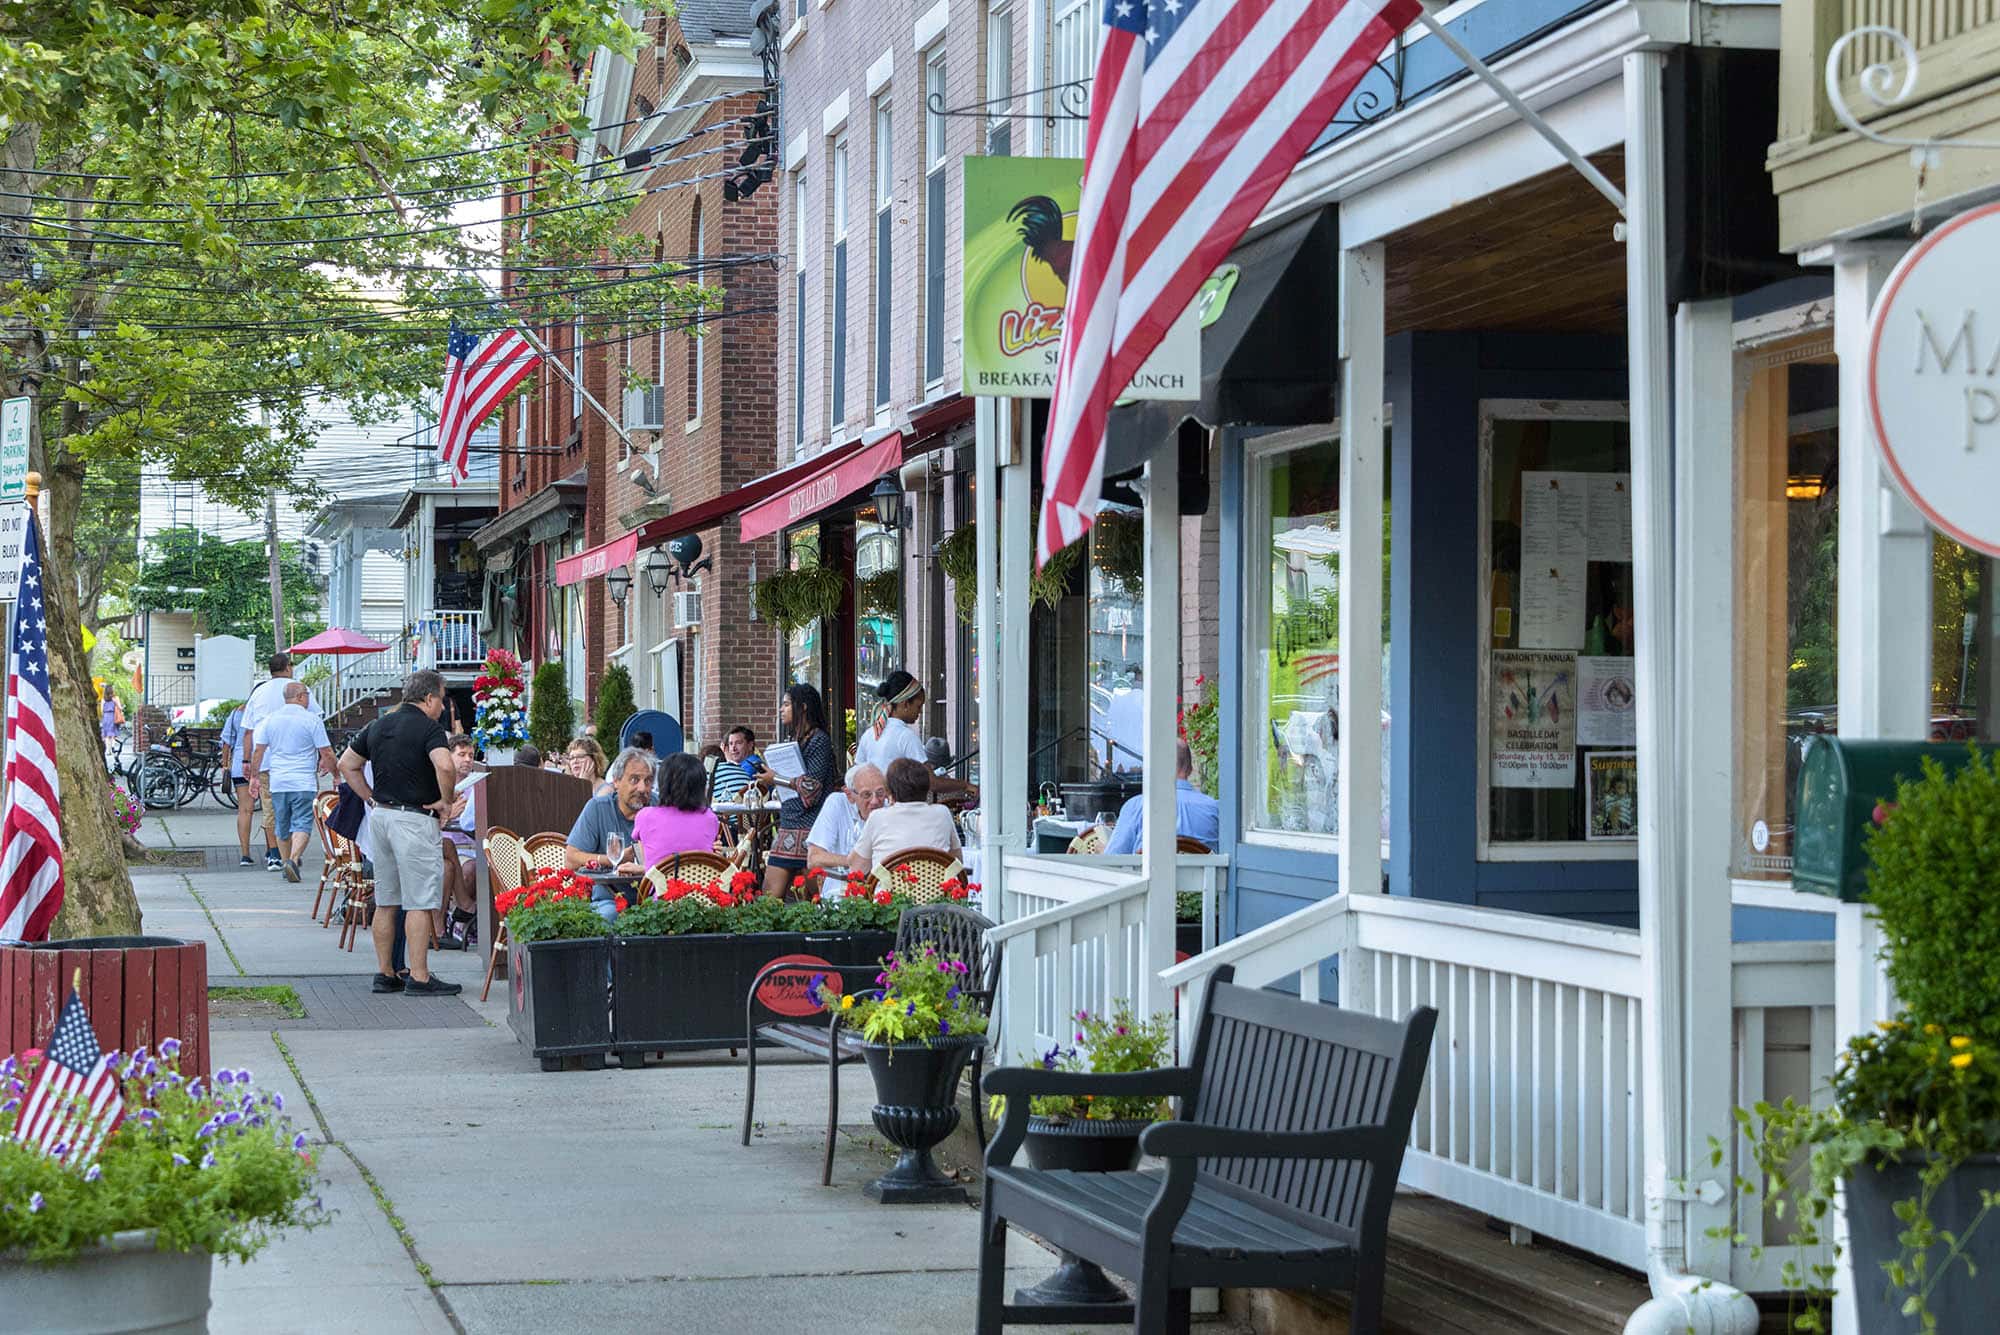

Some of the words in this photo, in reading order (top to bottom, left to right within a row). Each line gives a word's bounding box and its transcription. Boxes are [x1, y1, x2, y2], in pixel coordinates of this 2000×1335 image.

[1001, 303, 1064, 355] Liz
[979, 371, 1055, 386] BREAKFA
[1129, 374, 1184, 388] UNCH
[13, 406, 19, 423] 2
[8, 428, 23, 442] HOUR
[3, 444, 26, 457] PARKING
[2, 518, 10, 532] DO
[11, 517, 21, 531] NOT
[2, 544, 19, 558] BLOCK
[1543, 654, 1576, 663] ANNUAL
[1507, 730, 1542, 739] BASTILLE
[1544, 730, 1560, 738] DAY
[1505, 741, 1559, 750] CELEBRATION
[1528, 752, 1543, 761] July
[1557, 753, 1573, 761] 2017
[1498, 762, 1528, 770] 12:00pm
